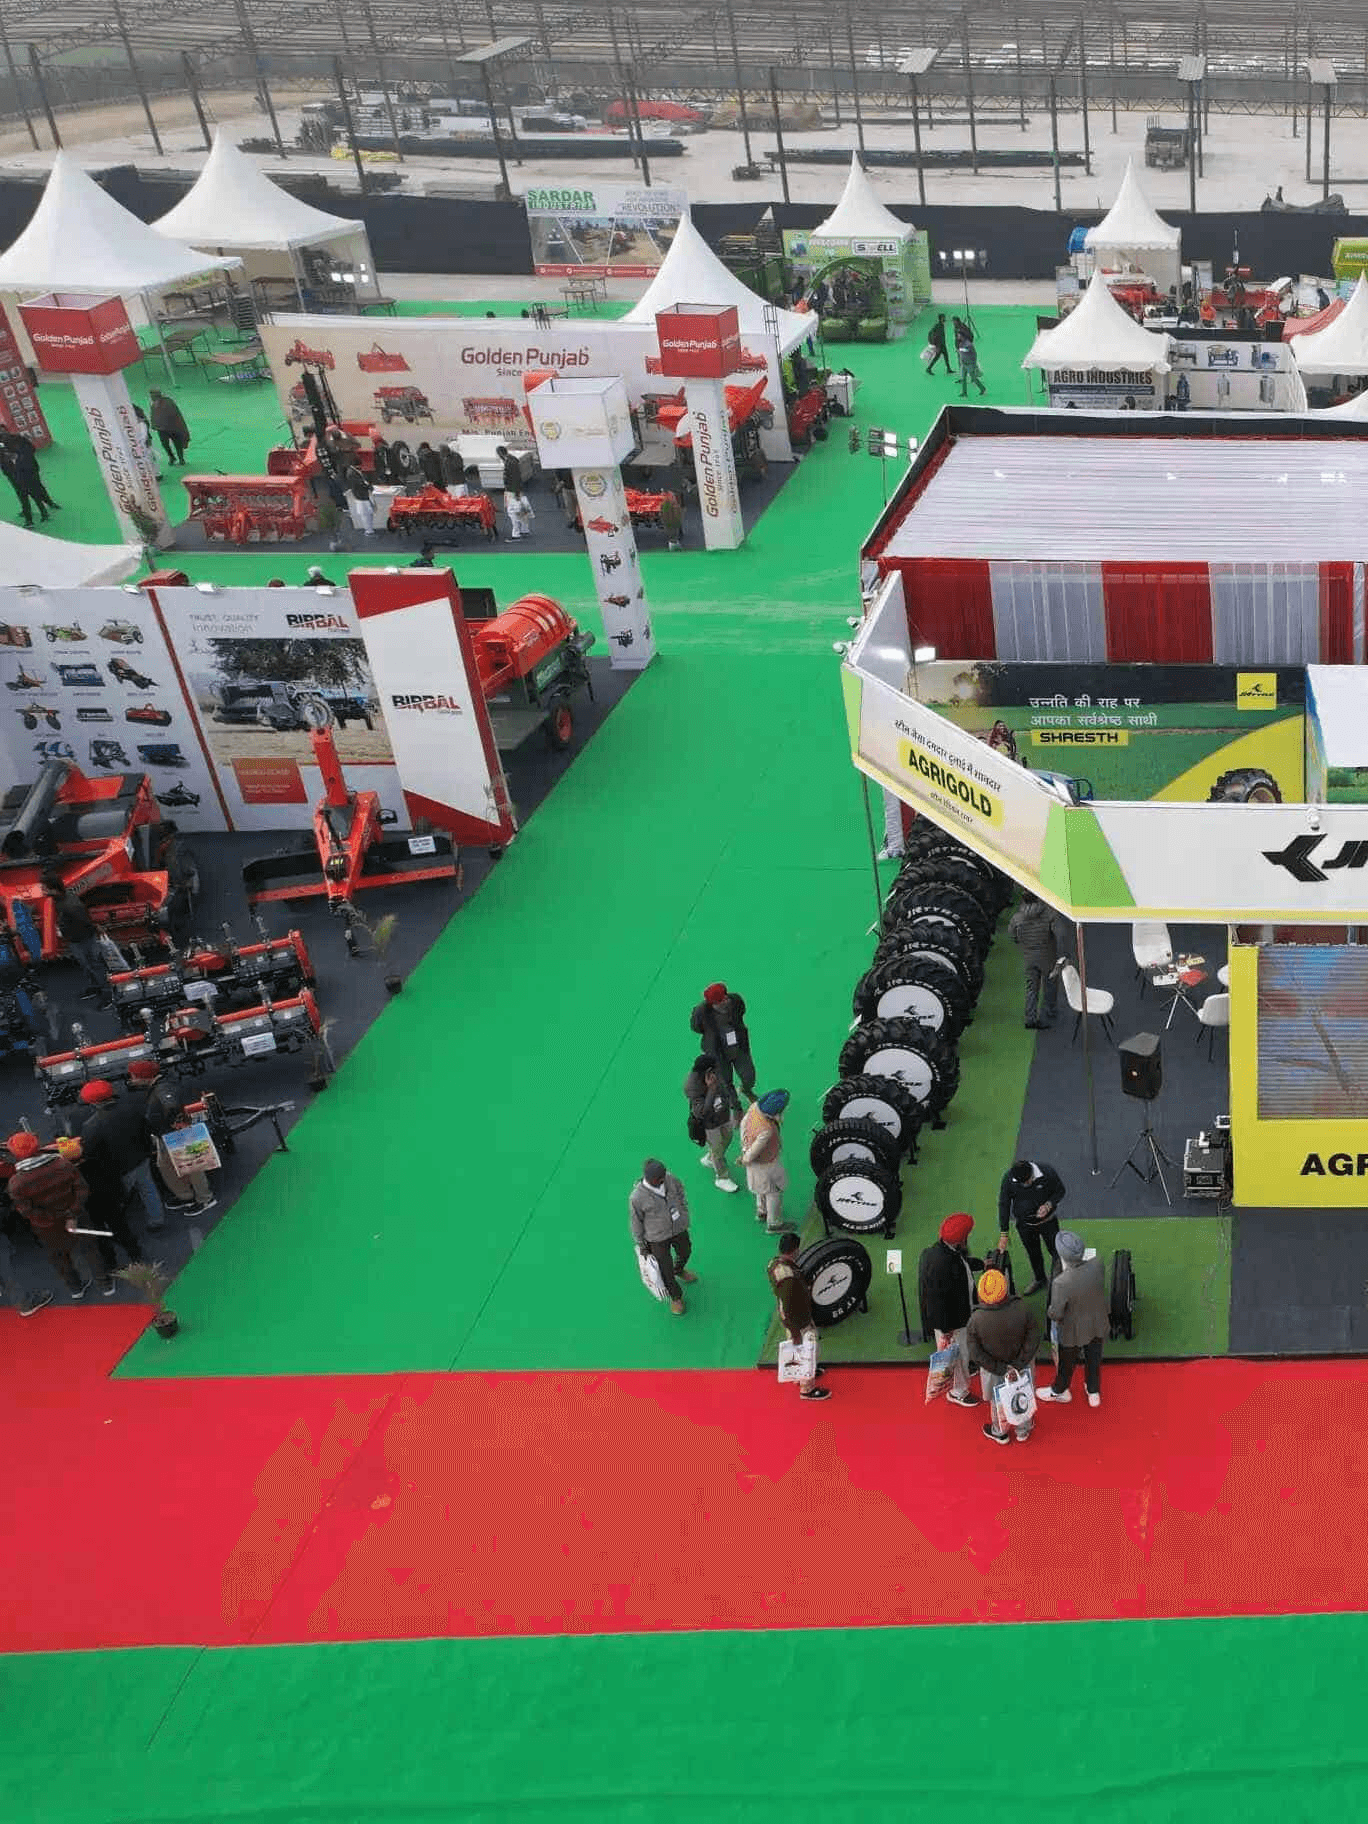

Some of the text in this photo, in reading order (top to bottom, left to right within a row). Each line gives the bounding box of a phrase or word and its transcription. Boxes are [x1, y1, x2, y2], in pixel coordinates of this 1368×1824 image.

[527, 190, 594, 201] SARDAR
[32, 332, 63, 344] Golden
[64, 334, 95, 346] Punjab
[662, 338, 690, 348] Golden
[690, 339, 717, 350] Punjab
[461, 347, 589, 370] Golden Punjab
[496, 367, 523, 378] Since
[1053, 370, 1153, 385] AGRO INDUSTRIES
[86, 406, 134, 514] Golden Punjab
[695, 411, 719, 518] Golden Punjab
[286, 614, 350, 630] BIRBAL
[391, 694, 462, 711] BIRBAL
[1029, 693, 1141, 710] उन्नति की राह पर
[1031, 711, 1158, 727] आपका सर्वश्रेष्ठ साथी
[1039, 732, 1120, 744] SHRESTH
[908, 748, 993, 818] AGRIGOLD
